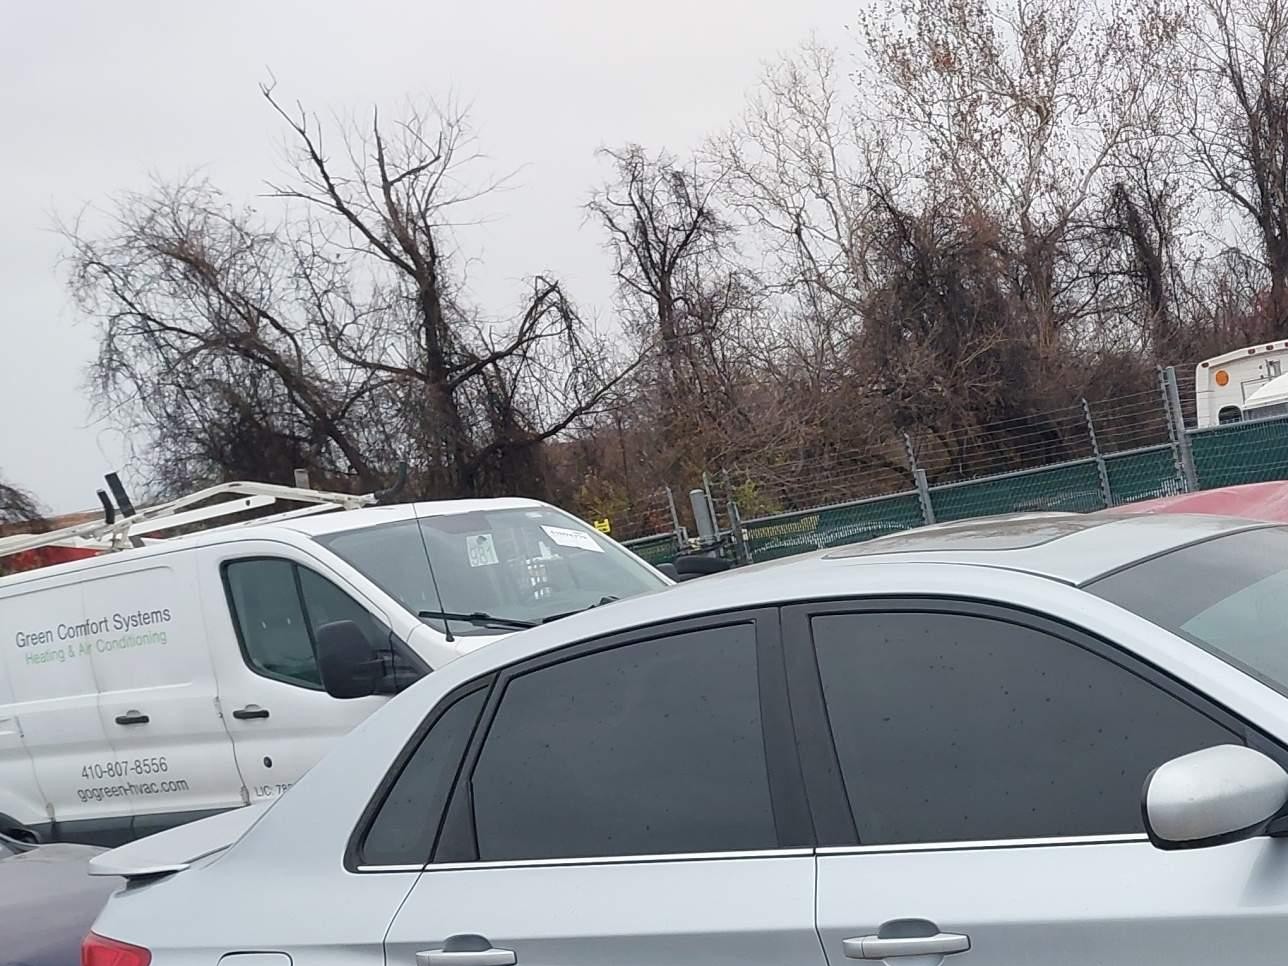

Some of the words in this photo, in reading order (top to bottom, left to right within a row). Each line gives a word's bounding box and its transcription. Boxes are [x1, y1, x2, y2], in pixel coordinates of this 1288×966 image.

[15, 630, 53, 648] Green
[57, 616, 110, 640] Comfort
[112, 608, 172, 632] Systems
[25, 648, 66, 664] Heating
[68, 645, 75, 658] &
[79, 642, 92, 656] Air
[95, 630, 168, 653] Conditioning
[81, 756, 169, 780] 410-807-8556
[77, 778, 189, 803] gogreen-hvac.com
